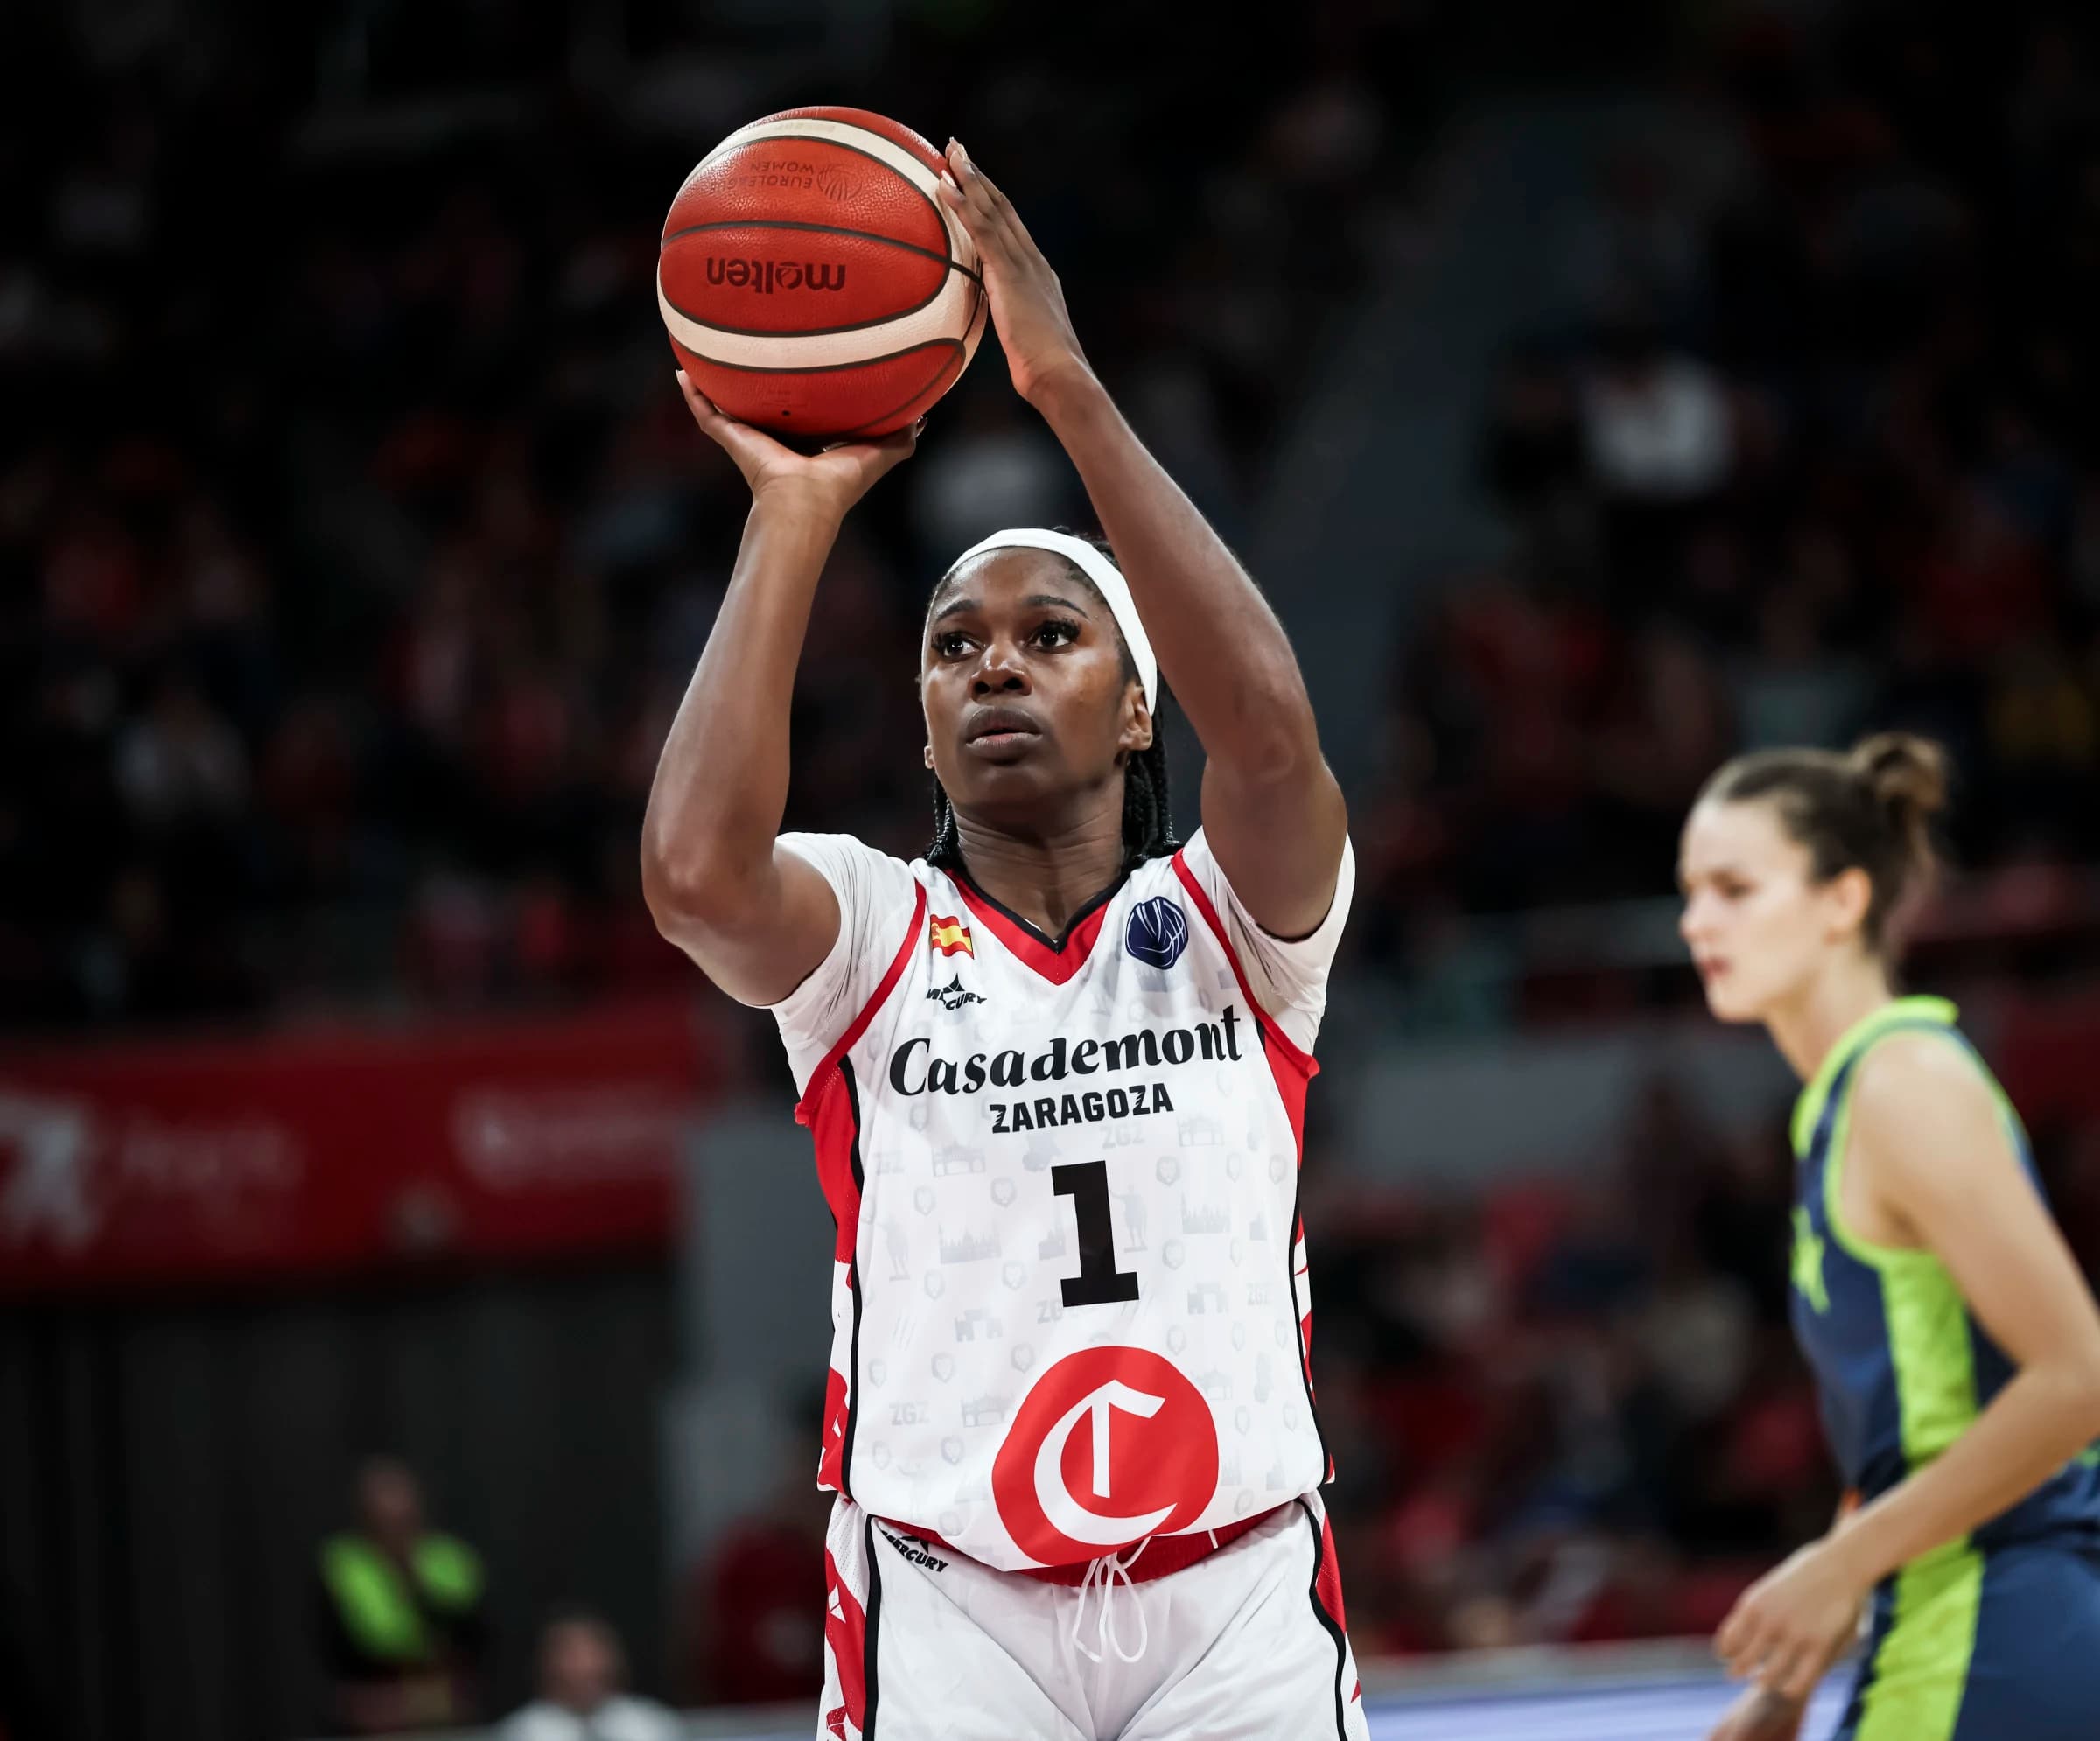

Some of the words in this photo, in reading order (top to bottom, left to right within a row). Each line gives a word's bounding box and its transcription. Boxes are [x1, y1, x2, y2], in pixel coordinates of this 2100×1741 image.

[710, 175, 813, 192] EUROLEGUE
[751, 161, 815, 175] WOMEN
[706, 257, 845, 294] molten
[925, 988, 988, 1011] MCURY
[889, 1004, 1242, 1096] Casademont
[990, 1082, 1174, 1134] ZARAGOZA
[1051, 1160, 1140, 1308] 1
[889, 1401, 930, 1426] ZGZ
